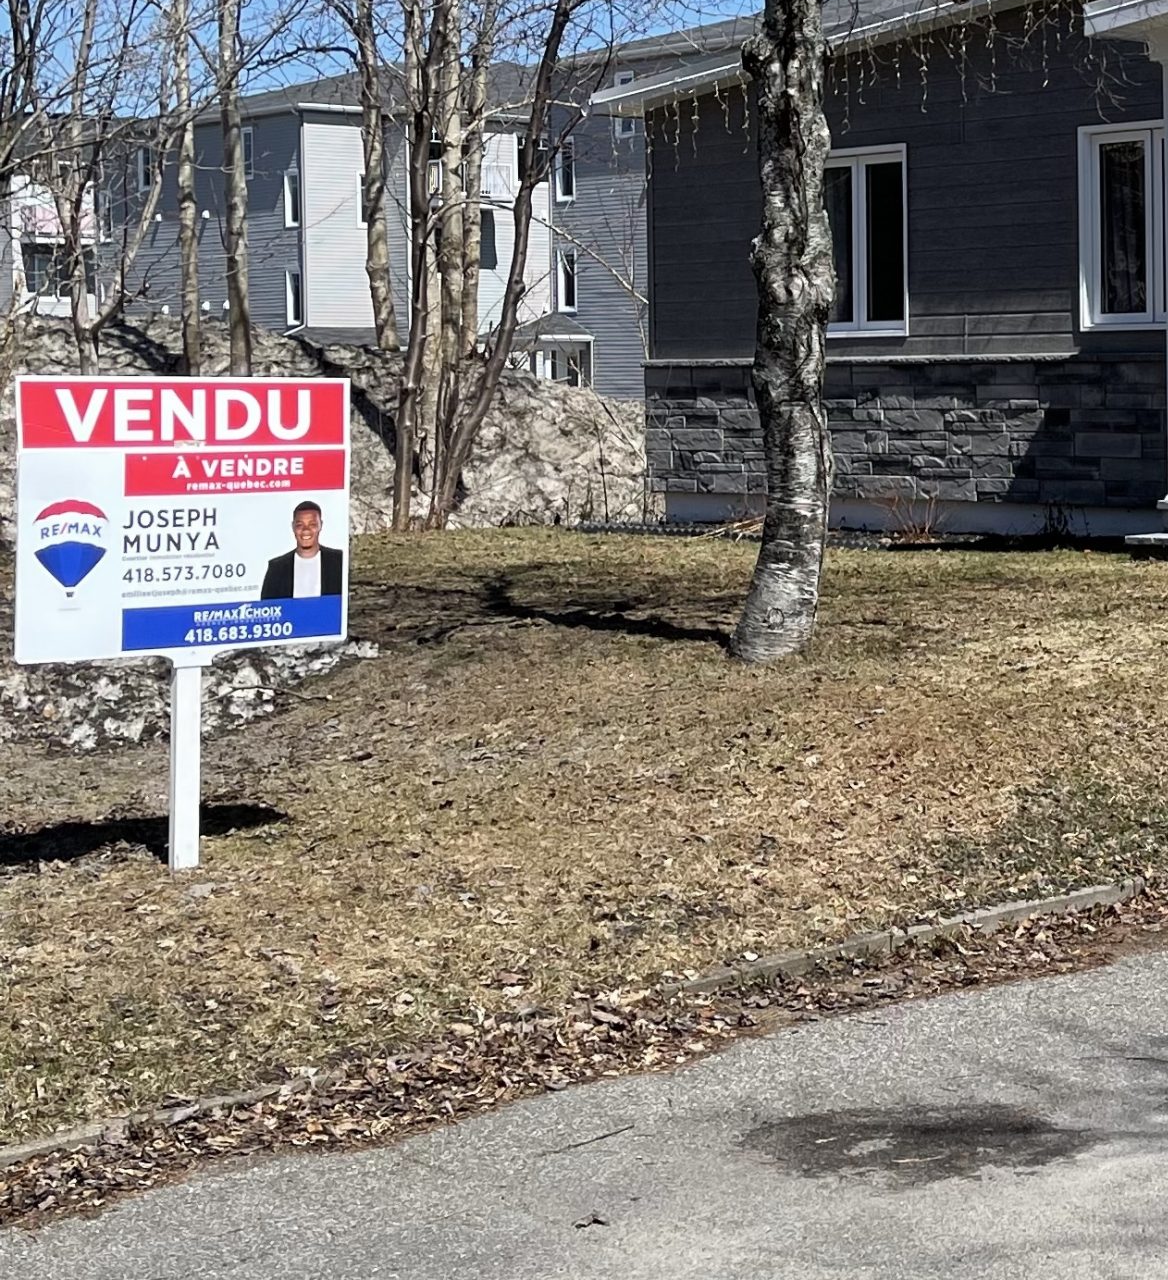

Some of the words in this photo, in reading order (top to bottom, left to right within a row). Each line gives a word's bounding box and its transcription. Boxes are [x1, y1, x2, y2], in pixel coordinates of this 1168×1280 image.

[55, 388, 312, 442] VENDU
[172, 456, 192, 478] À
[202, 457, 304, 477] VENDRE
[186, 479, 291, 492] remax-quebec.com
[122, 507, 217, 529] JOSEPH
[40, 522, 102, 539] RE/MAX
[123, 532, 220, 553] MUNYA
[122, 563, 246, 583] 418.573.7080
[184, 622, 293, 643] 418.683.9300
